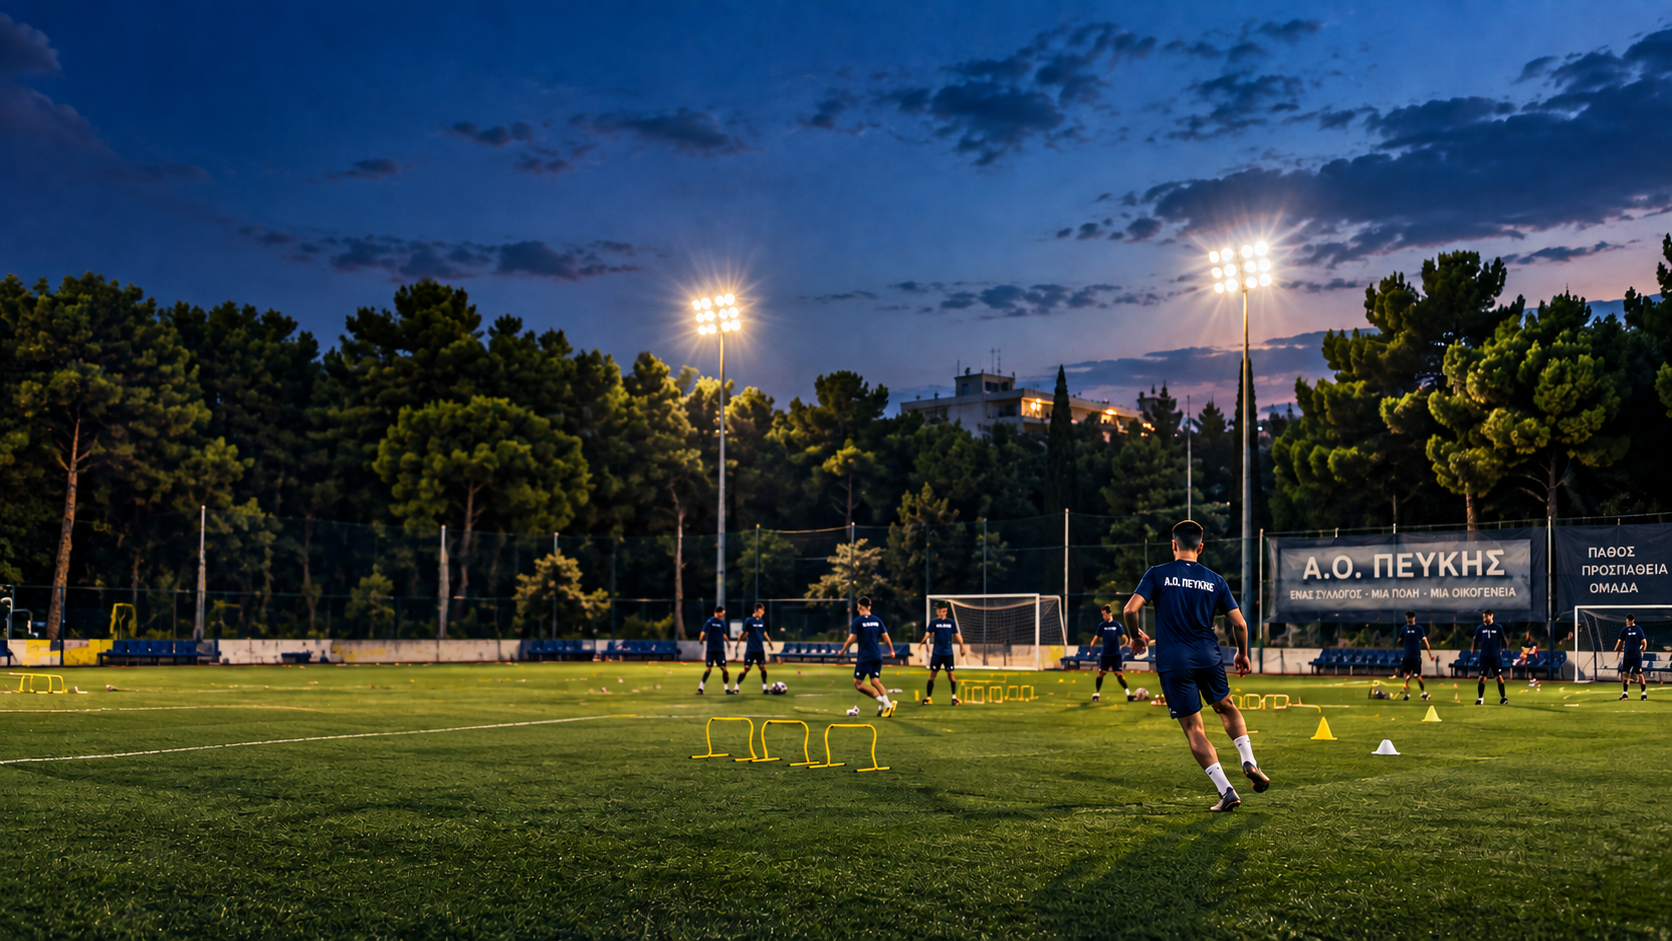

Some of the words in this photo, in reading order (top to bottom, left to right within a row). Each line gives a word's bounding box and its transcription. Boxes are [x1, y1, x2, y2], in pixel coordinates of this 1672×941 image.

[1588, 546, 1636, 558] ΠΑΘΟΣ
[1303, 554, 1361, 580] Α.Ο.
[1374, 549, 1505, 578] ΠΕΥΚΗΣ
[1582, 563, 1668, 576] ΠΡΟΣΠΑΘΕΙΑ
[1290, 590, 1314, 600] ΕΝΑΣ
[1316, 589, 1362, 600] ΣΥΛΛΟΓΟΣ
[1371, 589, 1390, 599] ΜΙΑ
[1392, 588, 1420, 598] ΠΟΛΗ
[1430, 588, 1449, 598] ΜΙΑ
[1452, 587, 1516, 598] ΟΙΚΟΓΕΝΕΙΑ
[1589, 582, 1639, 594] ΟΜΑΔΑ
